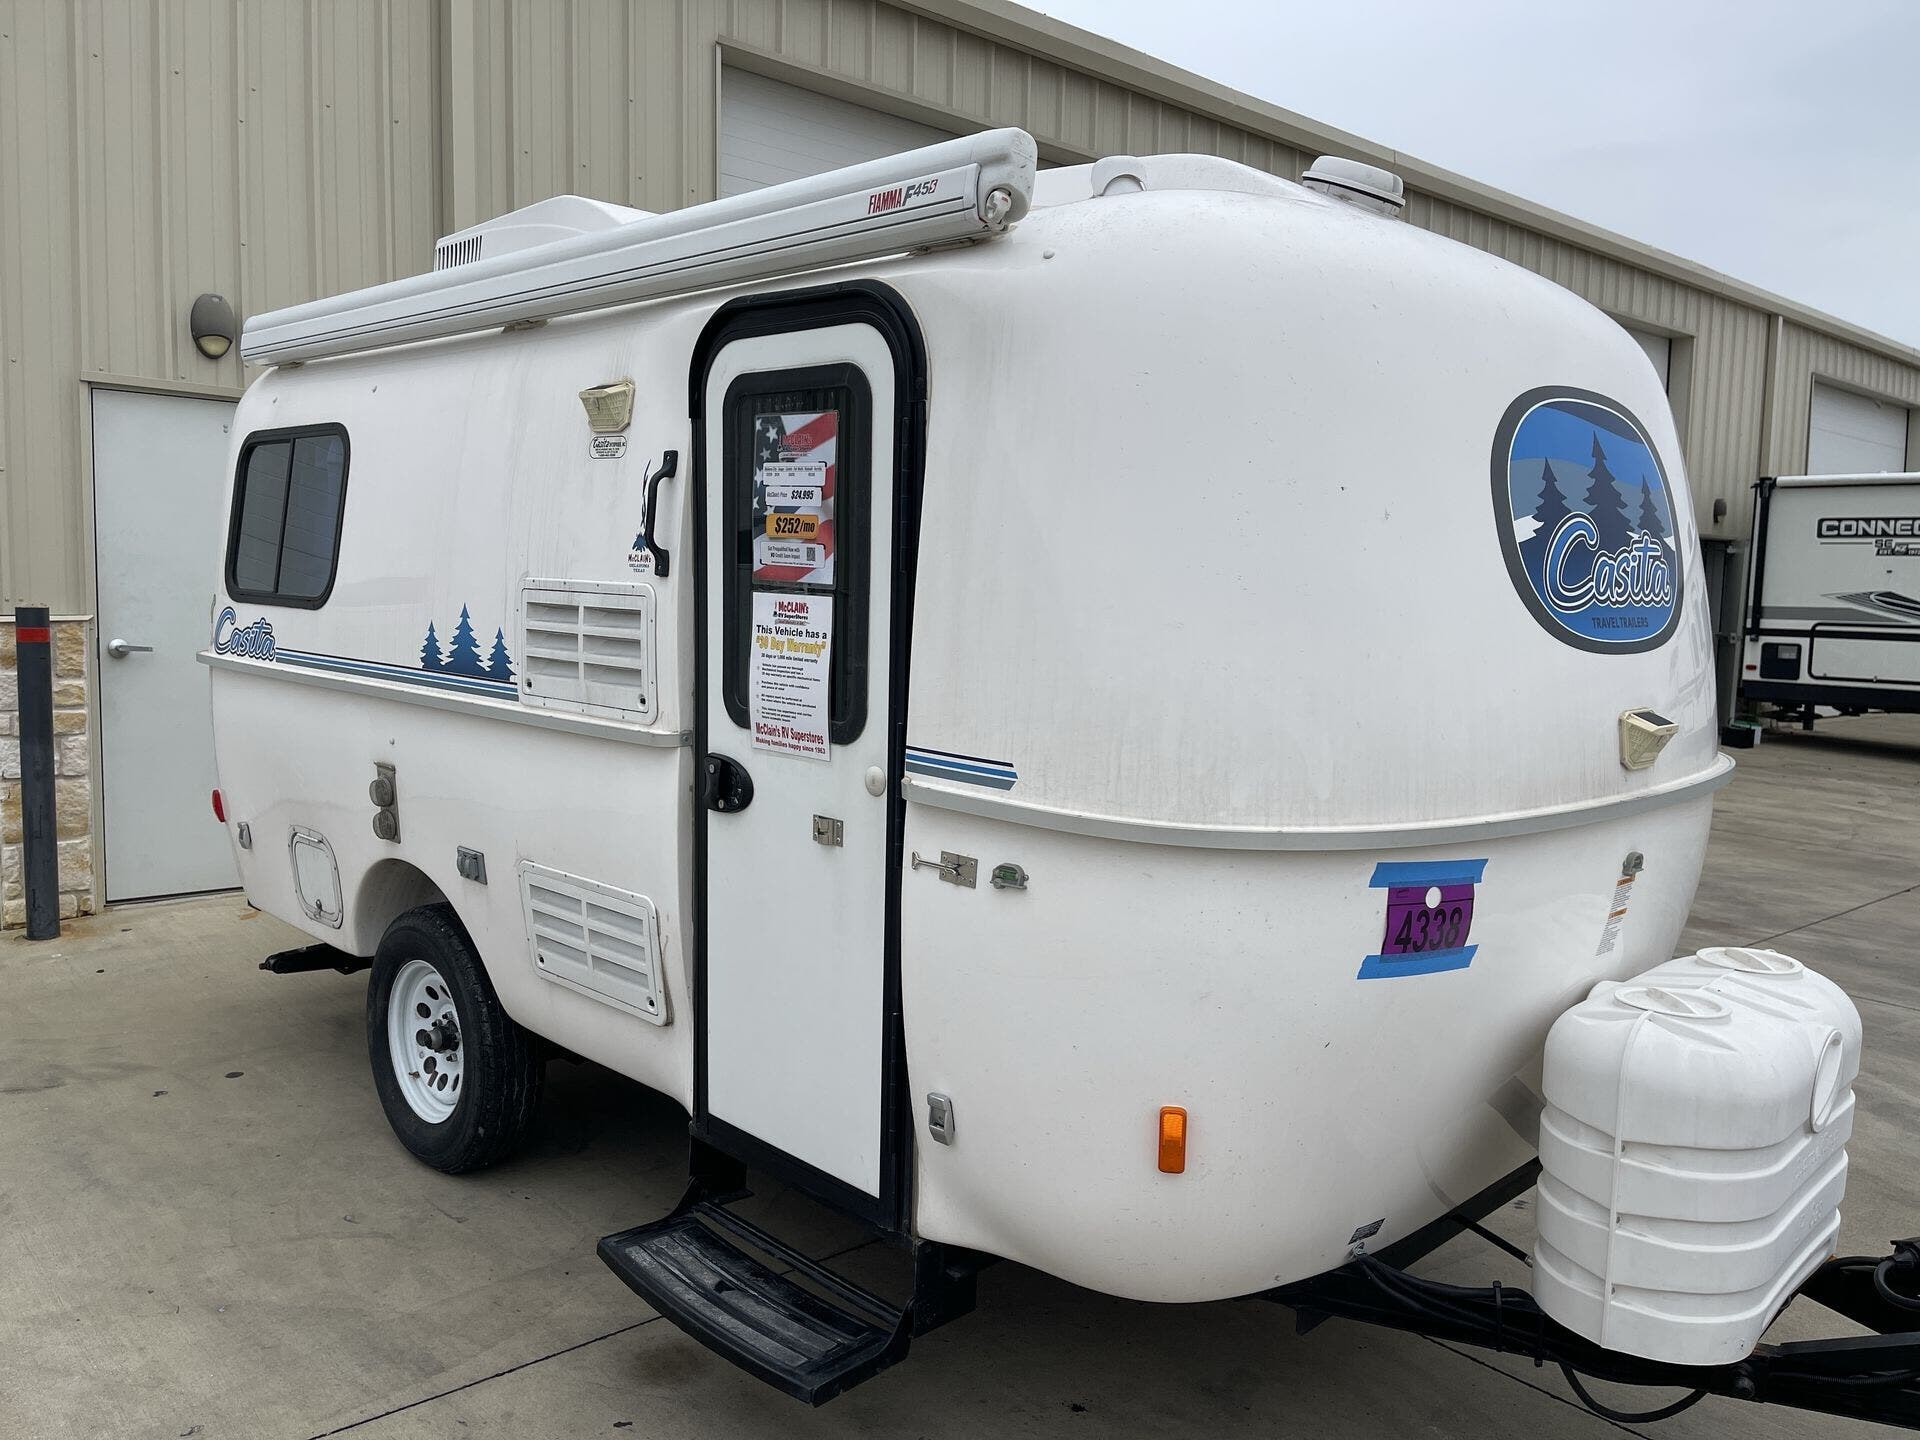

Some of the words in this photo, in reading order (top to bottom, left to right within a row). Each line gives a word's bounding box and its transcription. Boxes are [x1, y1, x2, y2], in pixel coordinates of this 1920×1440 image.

[868, 188, 902, 215] FIAMMA
[774, 516, 816, 534] $252/mo
[1544, 513, 1671, 610] Casita
[778, 601, 809, 614] McCLAIN's
[1592, 616, 1620, 628] TRAVEL
[1620, 617, 1648, 628] TRAILERS
[214, 606, 276, 662] Casita
[756, 624, 772, 634] This
[774, 626, 804, 638] Vehicle
[806, 628, 820, 638] has
[822, 632, 827, 640] a
[770, 636, 785, 654] Day
[756, 722, 780, 738] McClain's
[782, 726, 789, 739] RV
[790, 728, 824, 745] Superstores
[756, 736, 770, 746] Making
[771, 739, 788, 748] families
[788, 742, 801, 752] happy
[1394, 907, 1462, 954] 4338
